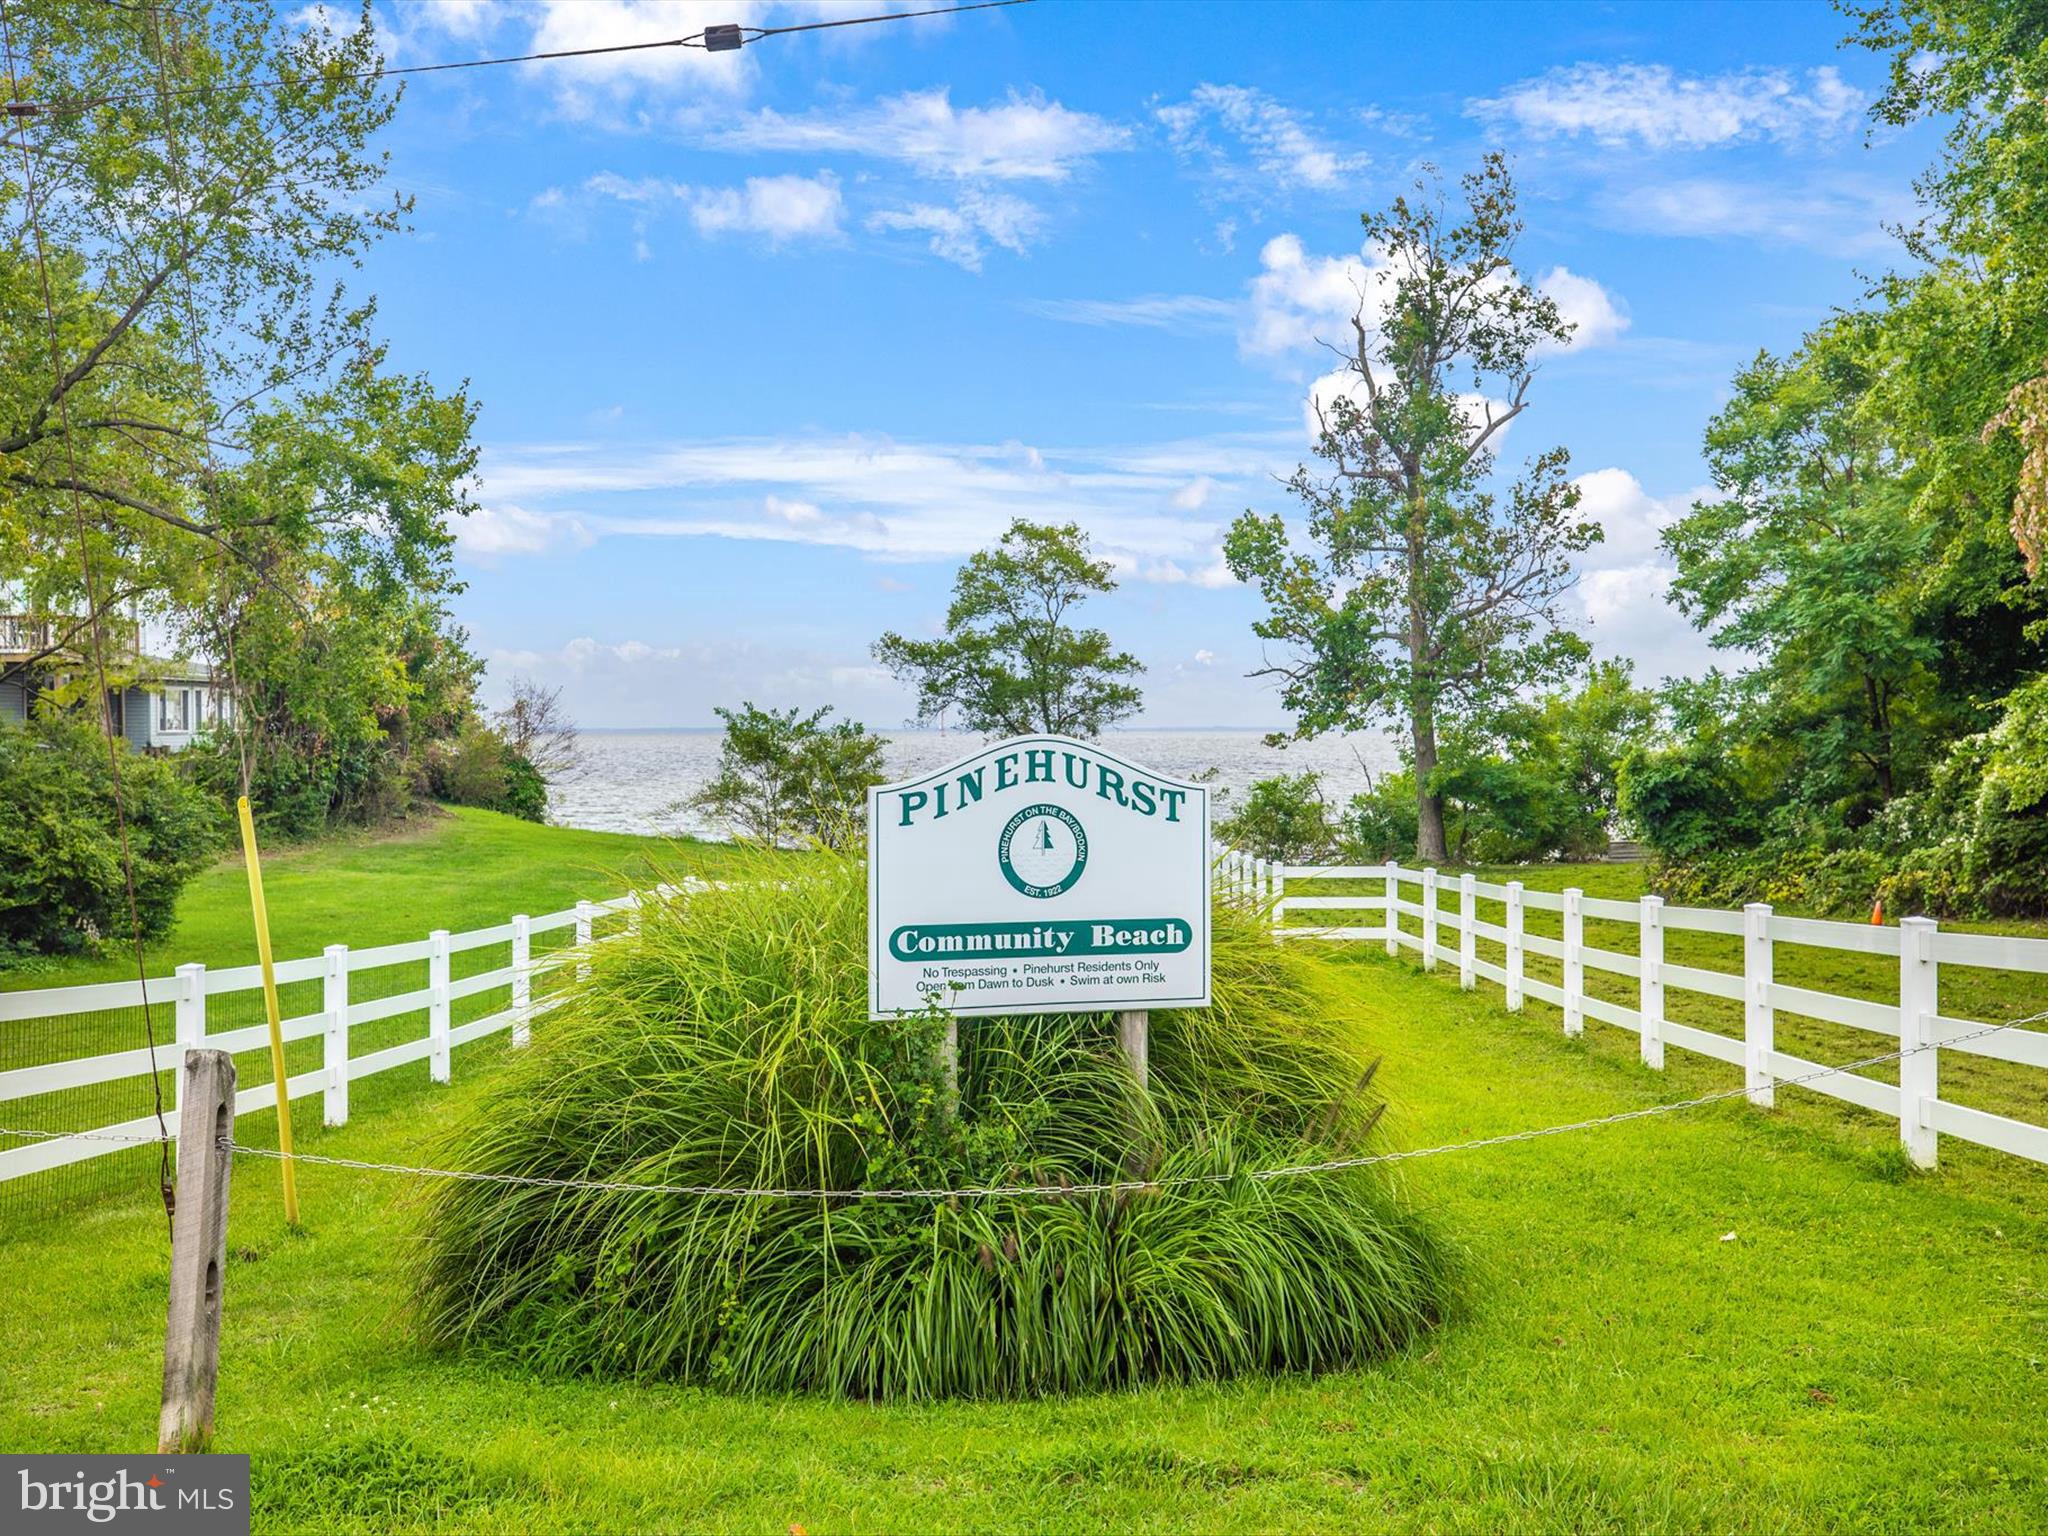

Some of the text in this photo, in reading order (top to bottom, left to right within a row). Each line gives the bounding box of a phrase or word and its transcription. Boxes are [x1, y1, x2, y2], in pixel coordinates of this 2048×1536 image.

[899, 750, 1186, 826] PINEHURST
[1001, 806, 1086, 863] PINEHURST ON THE BAY/BODKIN
[1024, 886, 1041, 896] EST.
[897, 923, 1184, 953] Community Beach
[923, 960, 1160, 978] No Trespassing Pinehurst Residents Only
[916, 981, 946, 993] Open
[978, 978, 1009, 989] Dawn
[1012, 978, 1023, 988] to
[1026, 976, 1054, 987] Dusk
[1070, 975, 1100, 986] Swim
[1103, 974, 1113, 985] at
[1116, 975, 1139, 984] own
[1142, 973, 1166, 984] Risk
